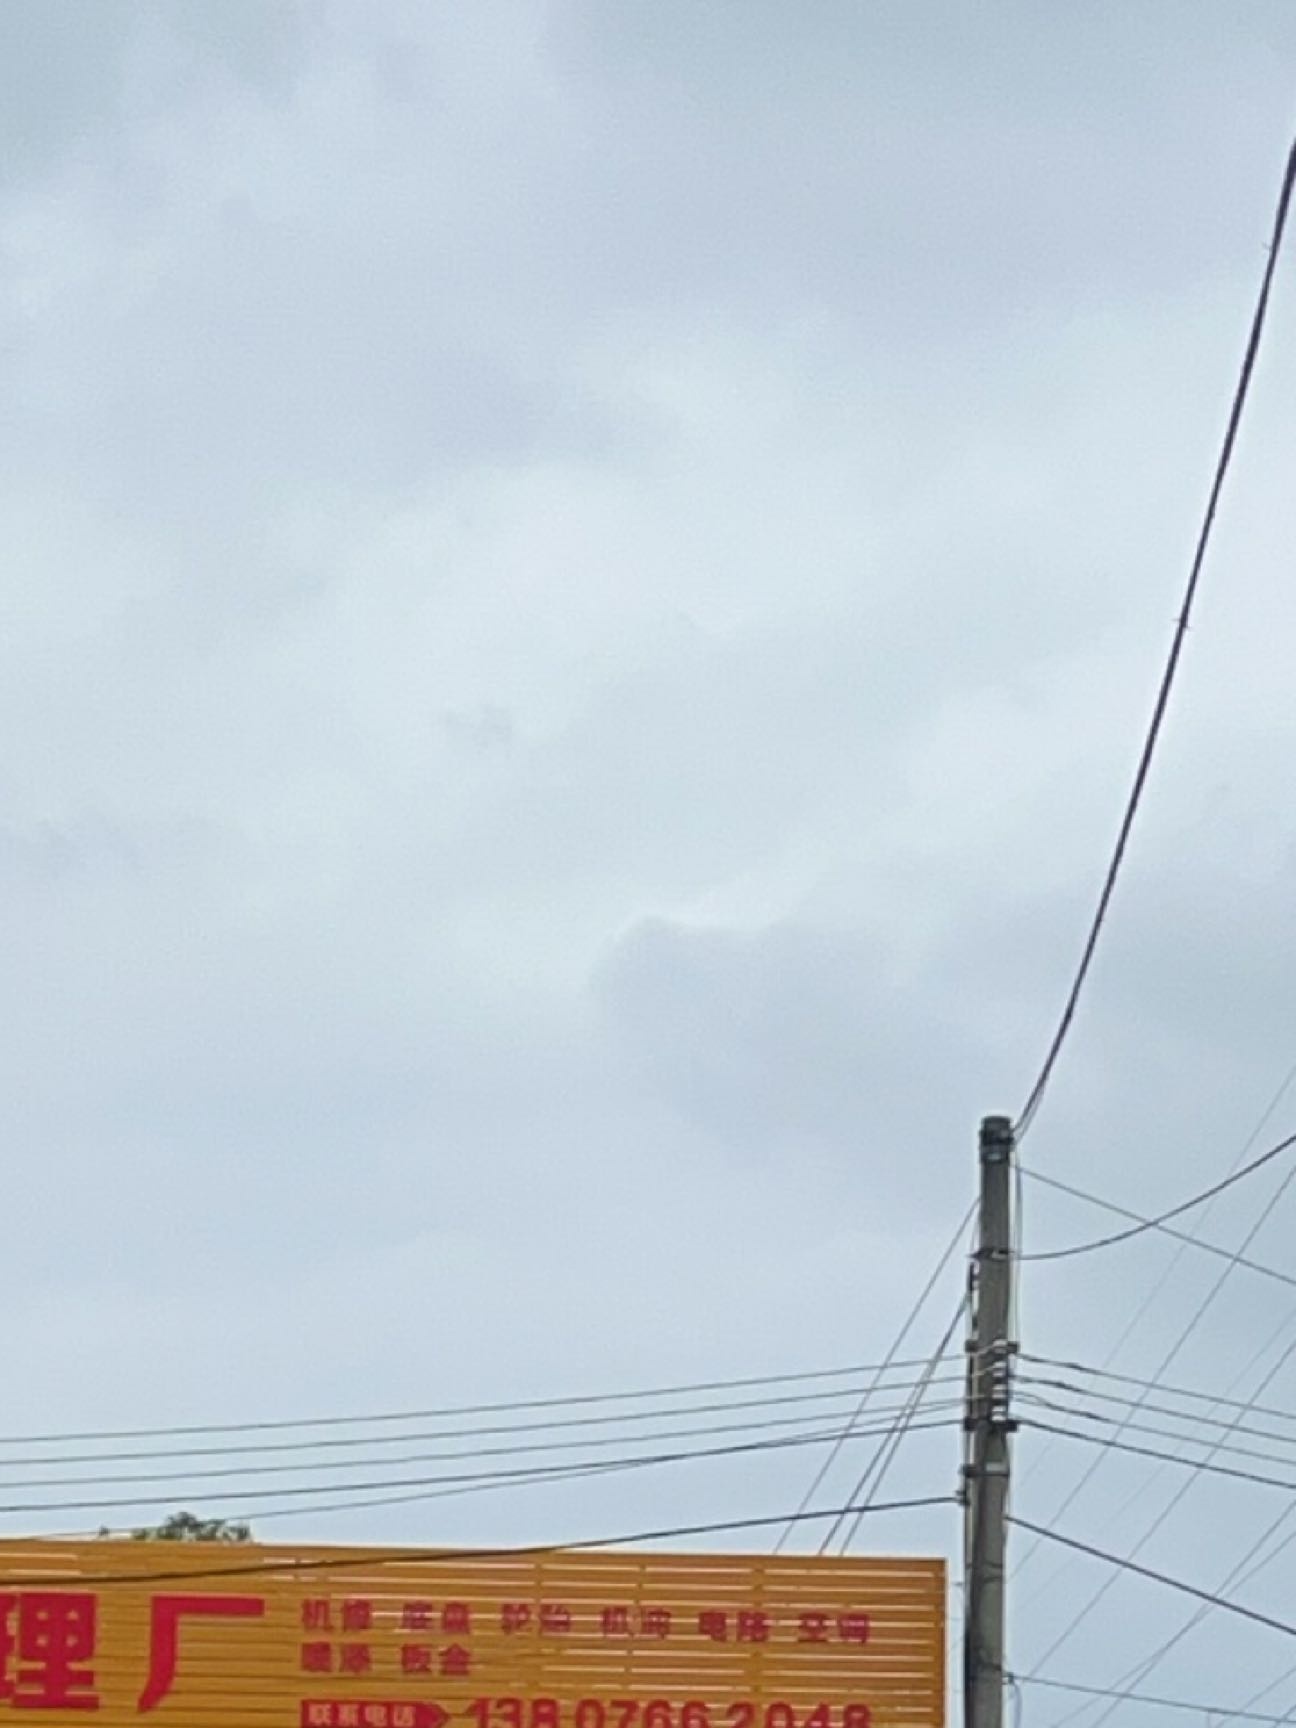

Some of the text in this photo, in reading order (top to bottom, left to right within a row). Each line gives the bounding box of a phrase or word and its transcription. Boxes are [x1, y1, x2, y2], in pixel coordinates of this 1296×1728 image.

[798, 1612, 871, 1645] 空调
[307, 1703, 417, 1728] 联系电话
